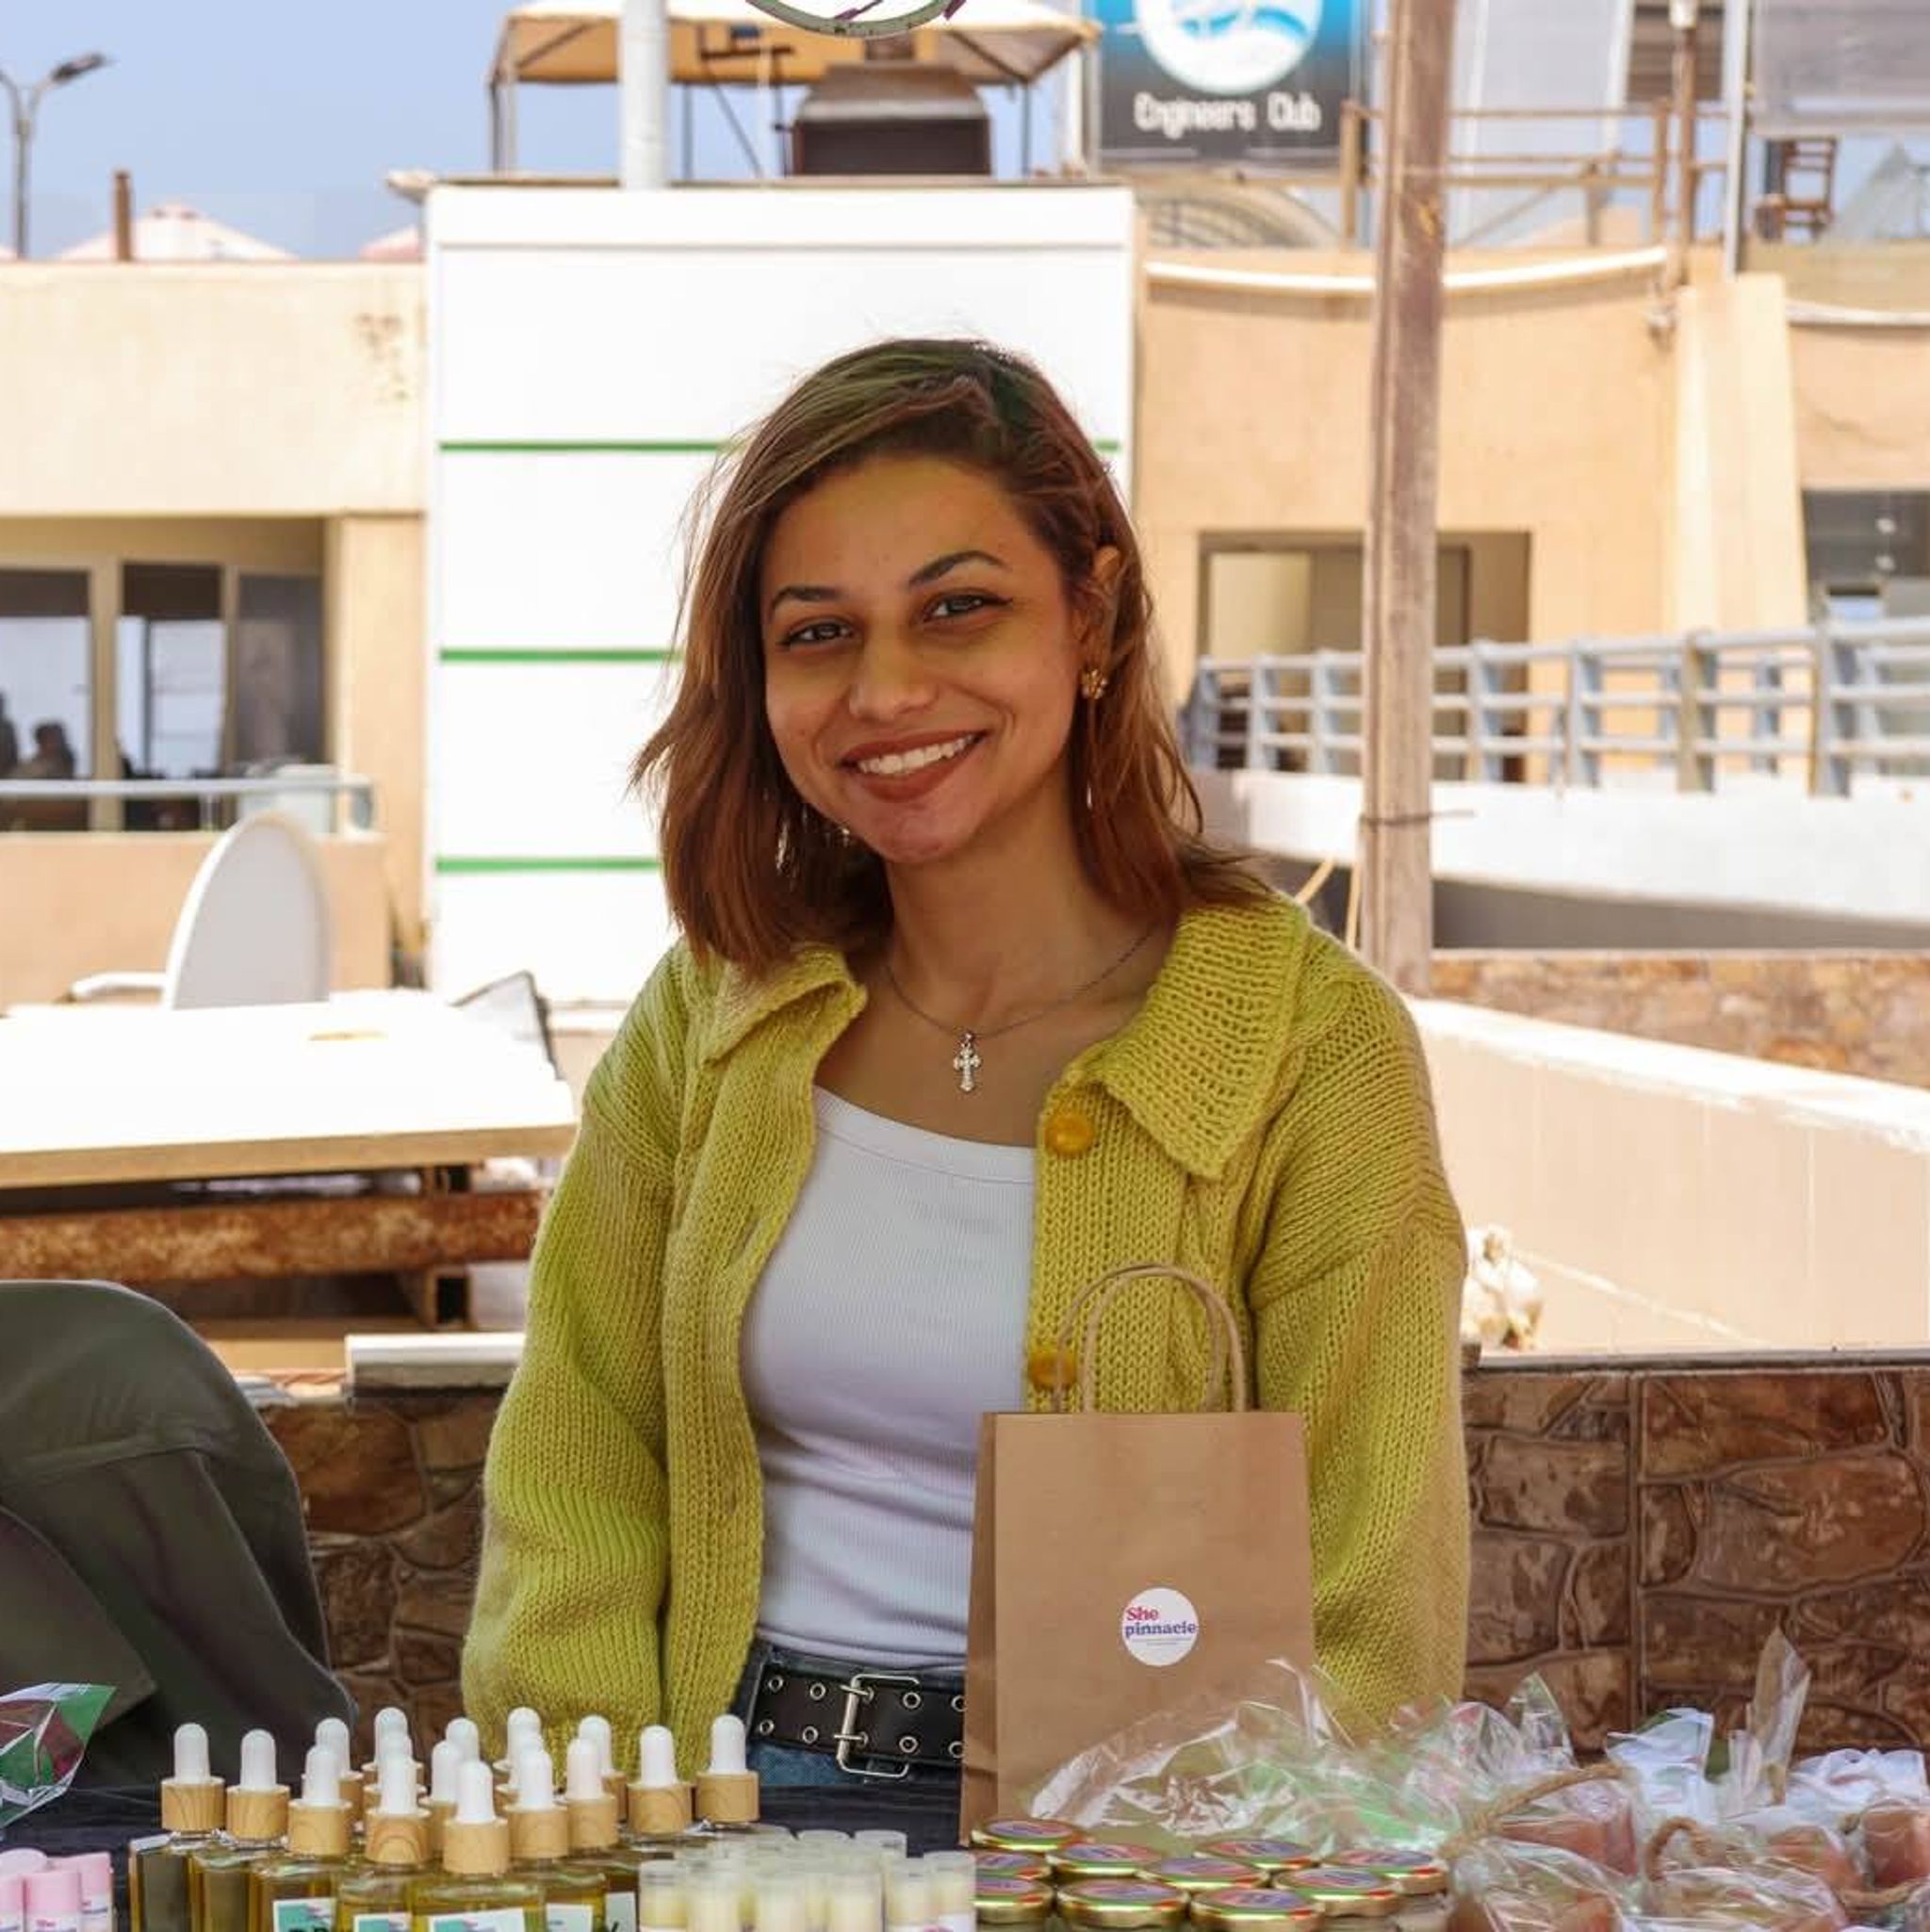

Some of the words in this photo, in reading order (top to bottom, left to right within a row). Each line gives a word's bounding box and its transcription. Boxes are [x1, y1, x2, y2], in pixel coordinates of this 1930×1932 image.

[1134, 92, 1256, 139] Engineers
[1267, 91, 1321, 131] Club
[1126, 1606, 1160, 1621] She
[1125, 1621, 1197, 1639] pinnacle
